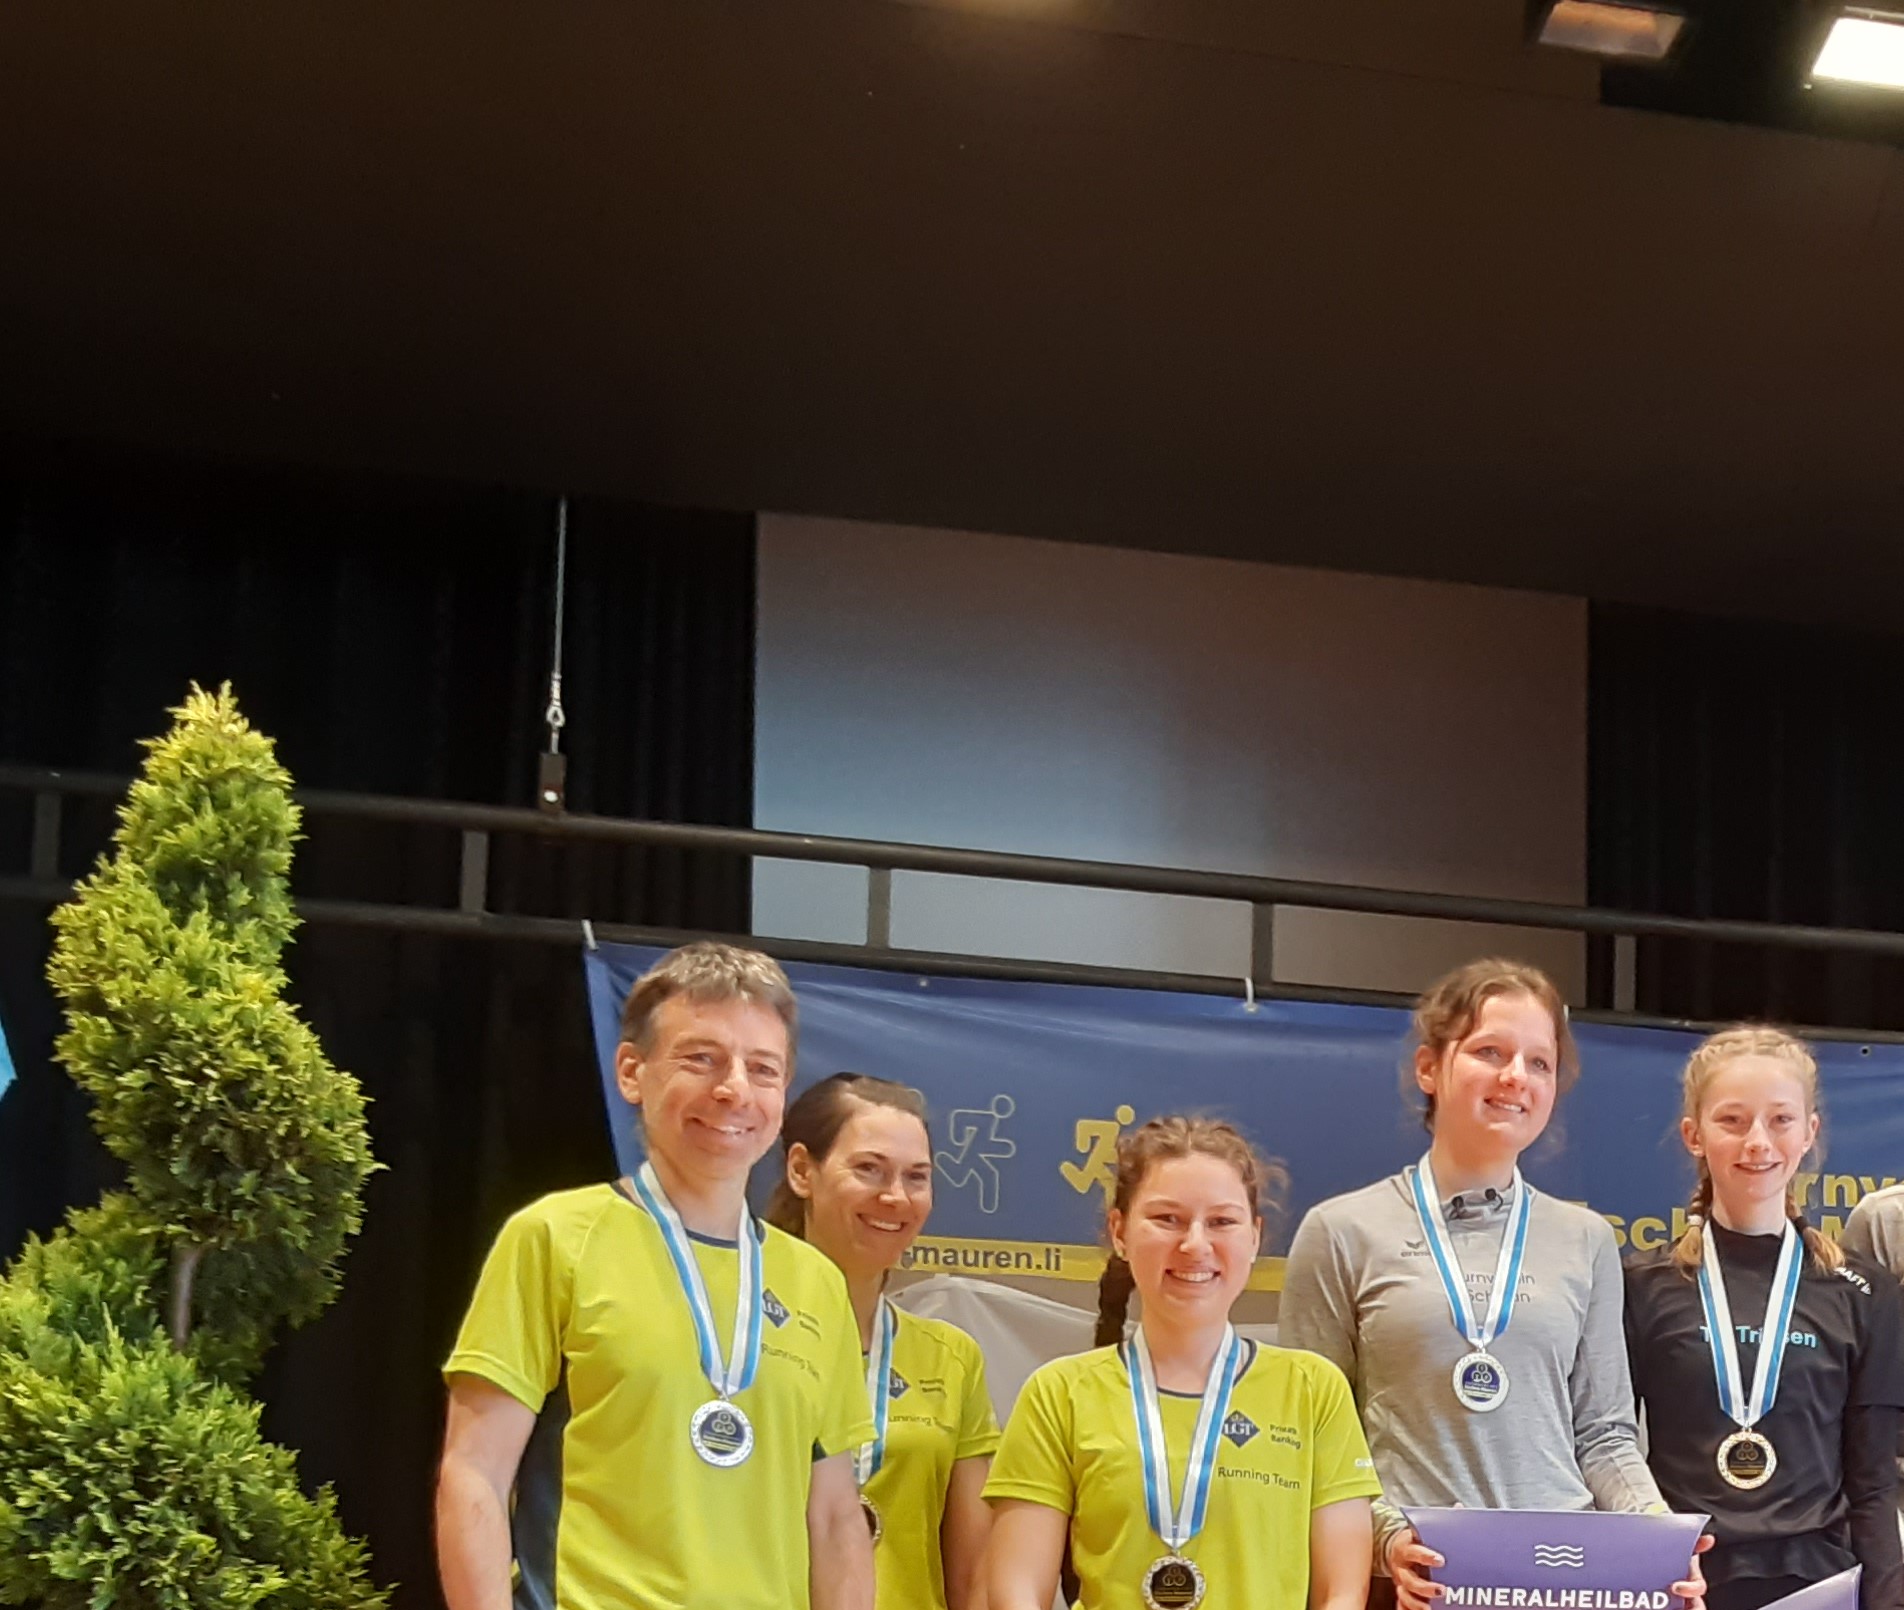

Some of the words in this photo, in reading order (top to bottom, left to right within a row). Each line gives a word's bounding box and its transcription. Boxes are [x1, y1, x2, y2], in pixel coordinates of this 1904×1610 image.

[1218, 1467, 1270, 1485] Running
[1274, 1473, 1300, 1489] Team
[1445, 1586, 1669, 1609] MINERALHEILBAD
